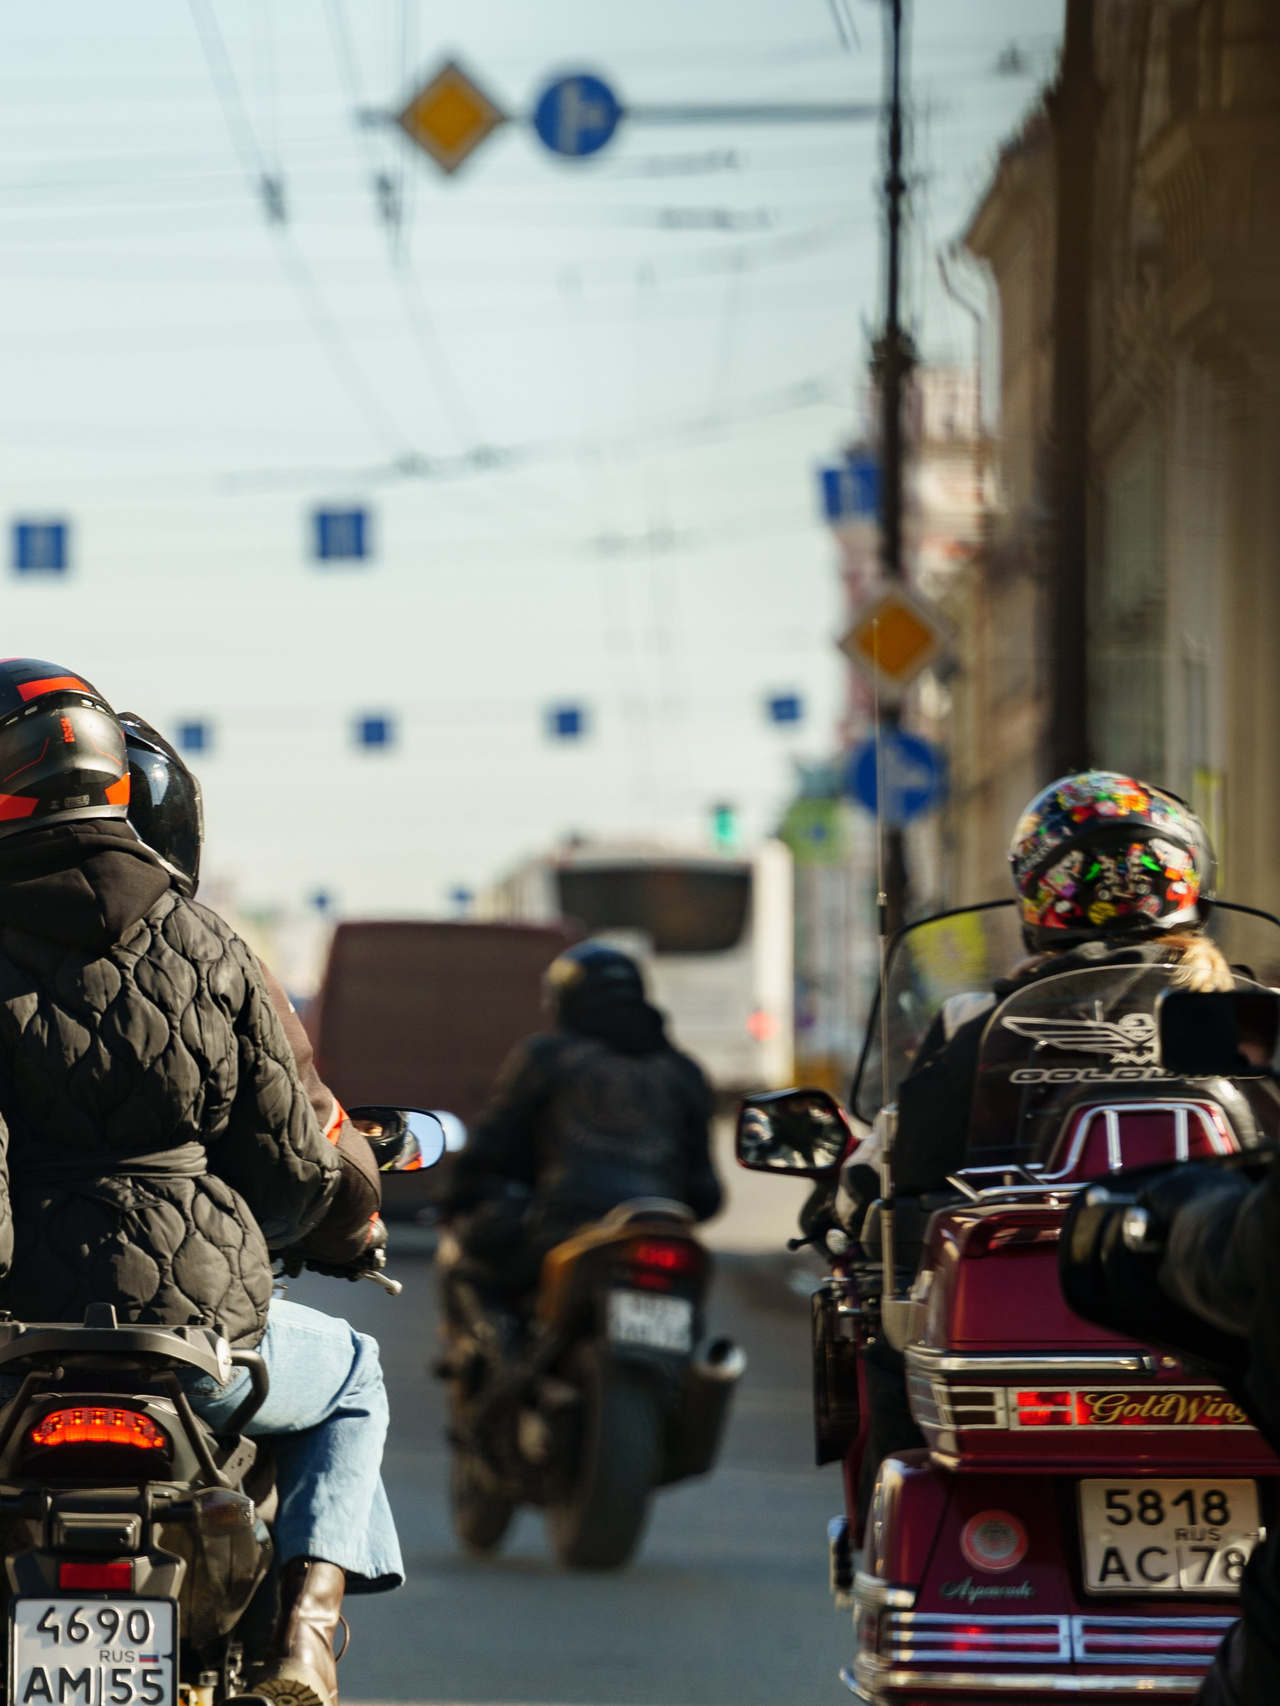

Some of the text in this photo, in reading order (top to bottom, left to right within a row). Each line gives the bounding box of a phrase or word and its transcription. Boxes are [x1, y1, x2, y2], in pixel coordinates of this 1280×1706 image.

[1104, 1488, 1231, 1526] 5818
[1175, 1528, 1221, 1542] RUS
[1098, 1546, 1247, 1583] AC 78
[36, 1605, 152, 1645] 4690
[99, 1650, 135, 1663] RUS
[23, 1667, 166, 1705] AM 55
